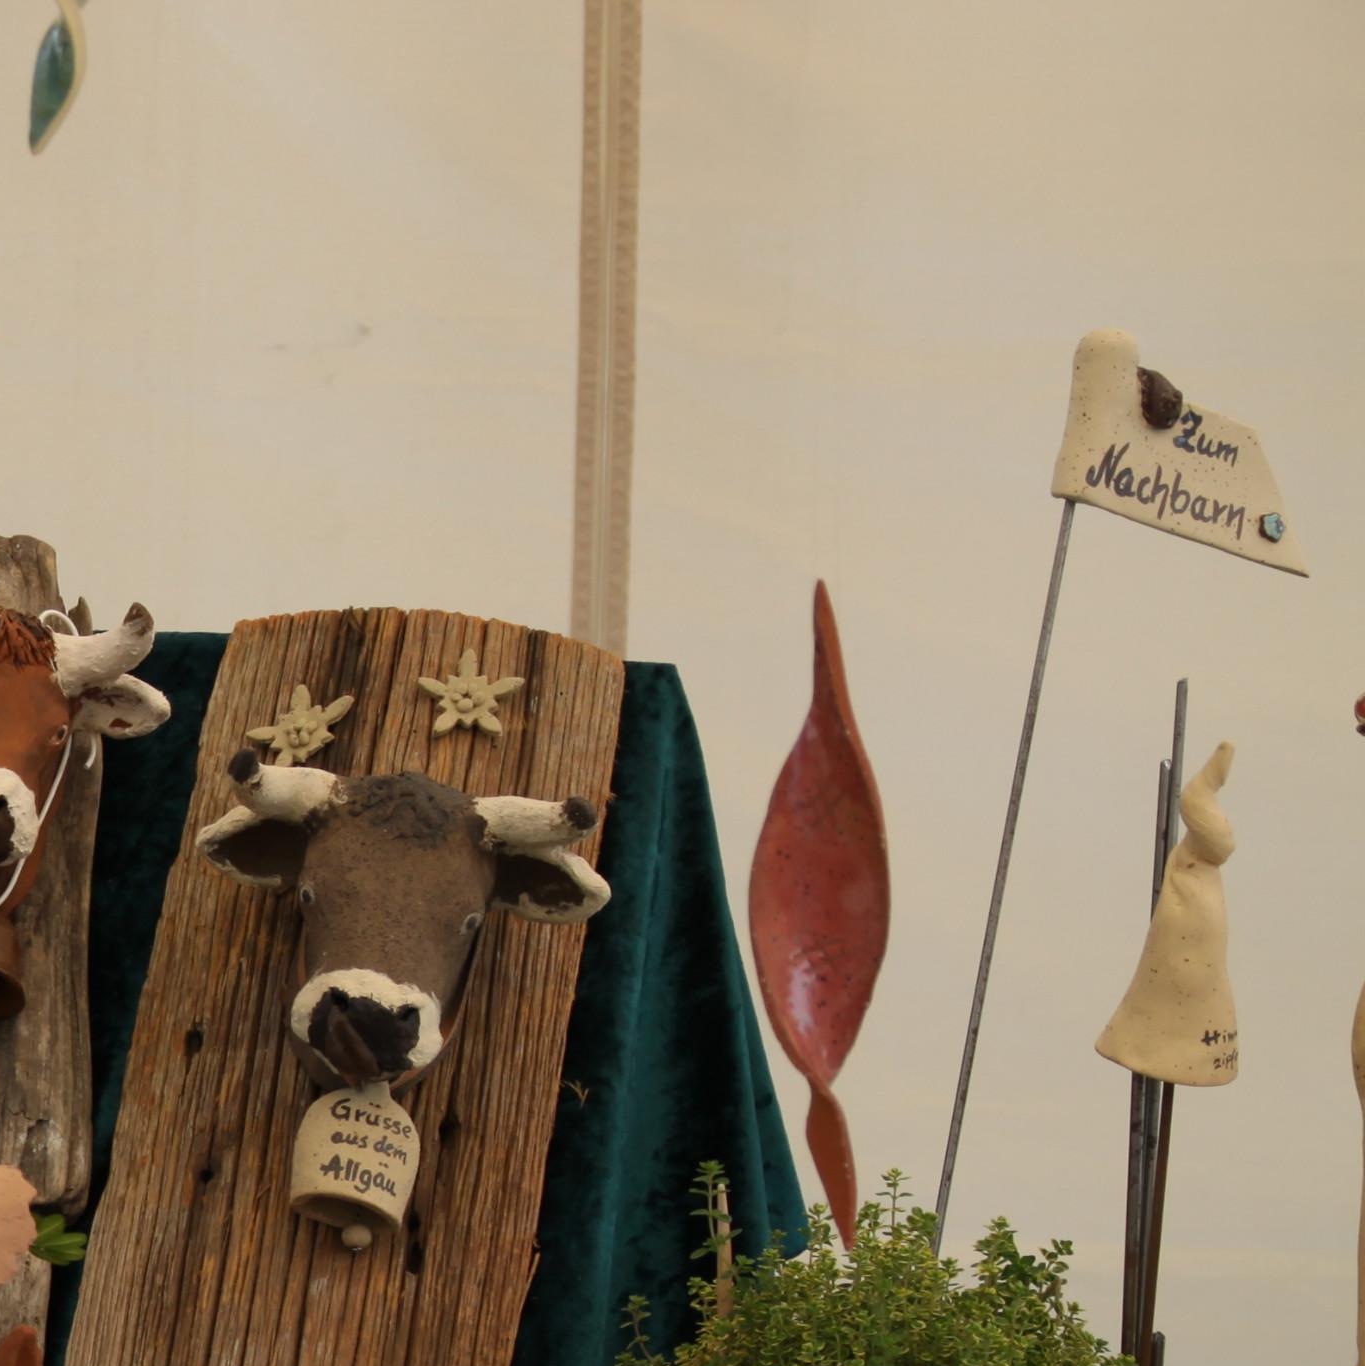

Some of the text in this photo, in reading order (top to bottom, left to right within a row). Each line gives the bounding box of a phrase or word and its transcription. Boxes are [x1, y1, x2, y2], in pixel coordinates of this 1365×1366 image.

[1173, 410, 1239, 468] Zum
[1085, 442, 1246, 541] Nachbarn
[330, 1098, 412, 1140] Grüsse
[330, 1130, 408, 1166] aus dem
[319, 1153, 397, 1197] Allgäu
